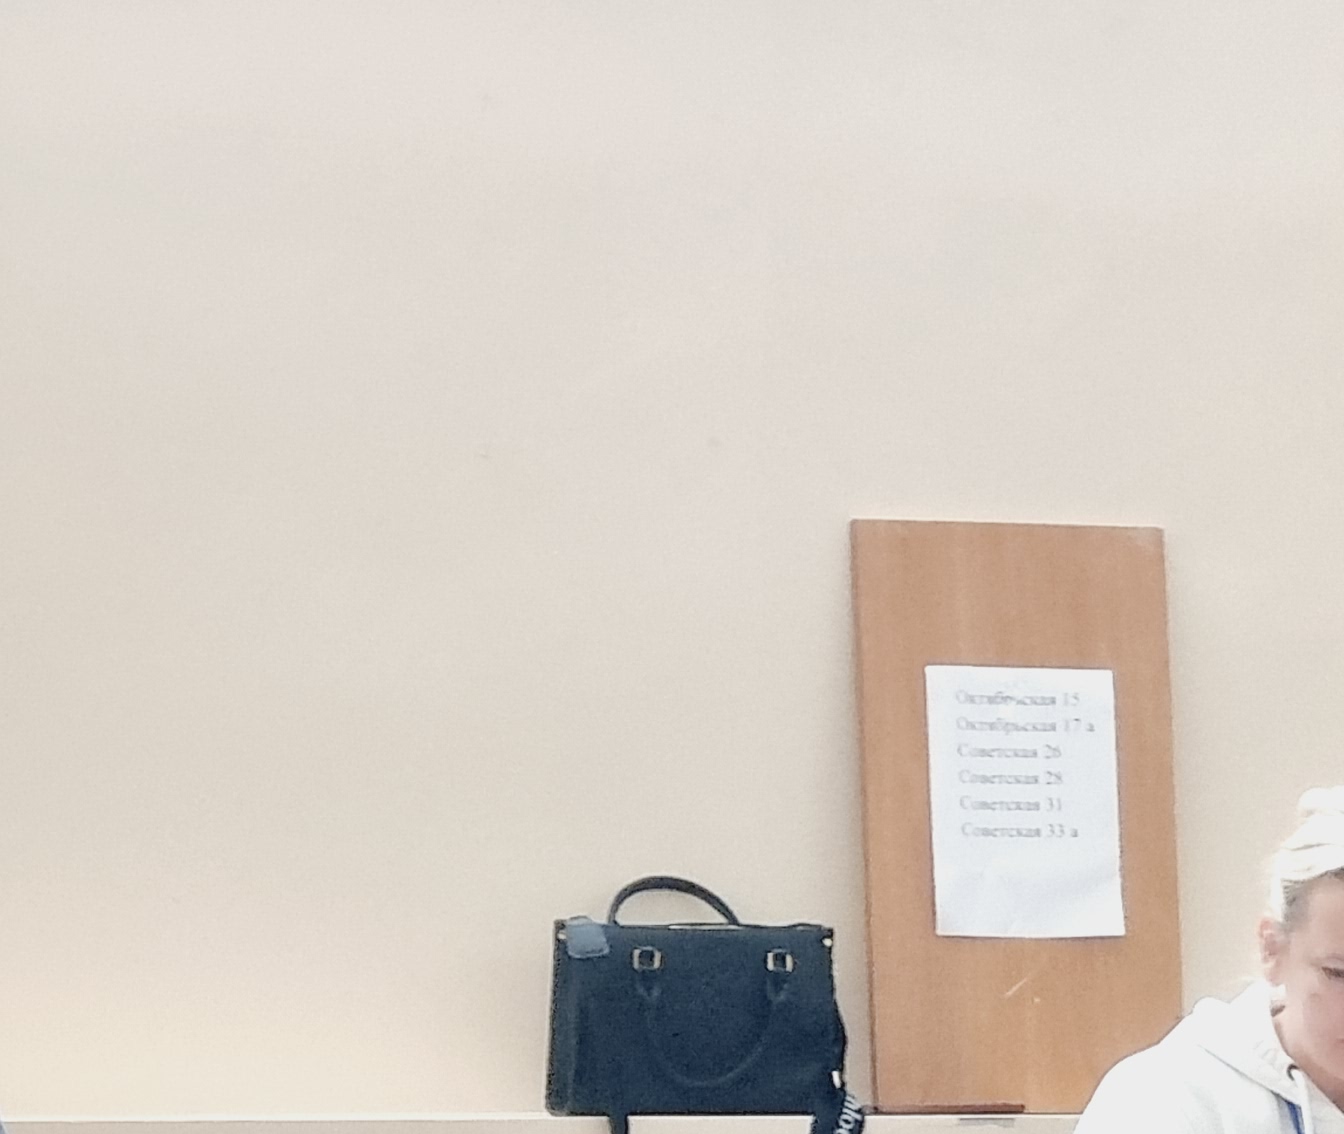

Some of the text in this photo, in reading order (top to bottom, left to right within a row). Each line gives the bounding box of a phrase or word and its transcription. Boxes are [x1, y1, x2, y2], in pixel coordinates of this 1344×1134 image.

[956, 716, 1057, 735] Октябрьская
[956, 743, 1038, 759] Советская
[958, 769, 1040, 785] Советская
[959, 795, 1041, 811] Советская
[961, 822, 1042, 838] Советская
